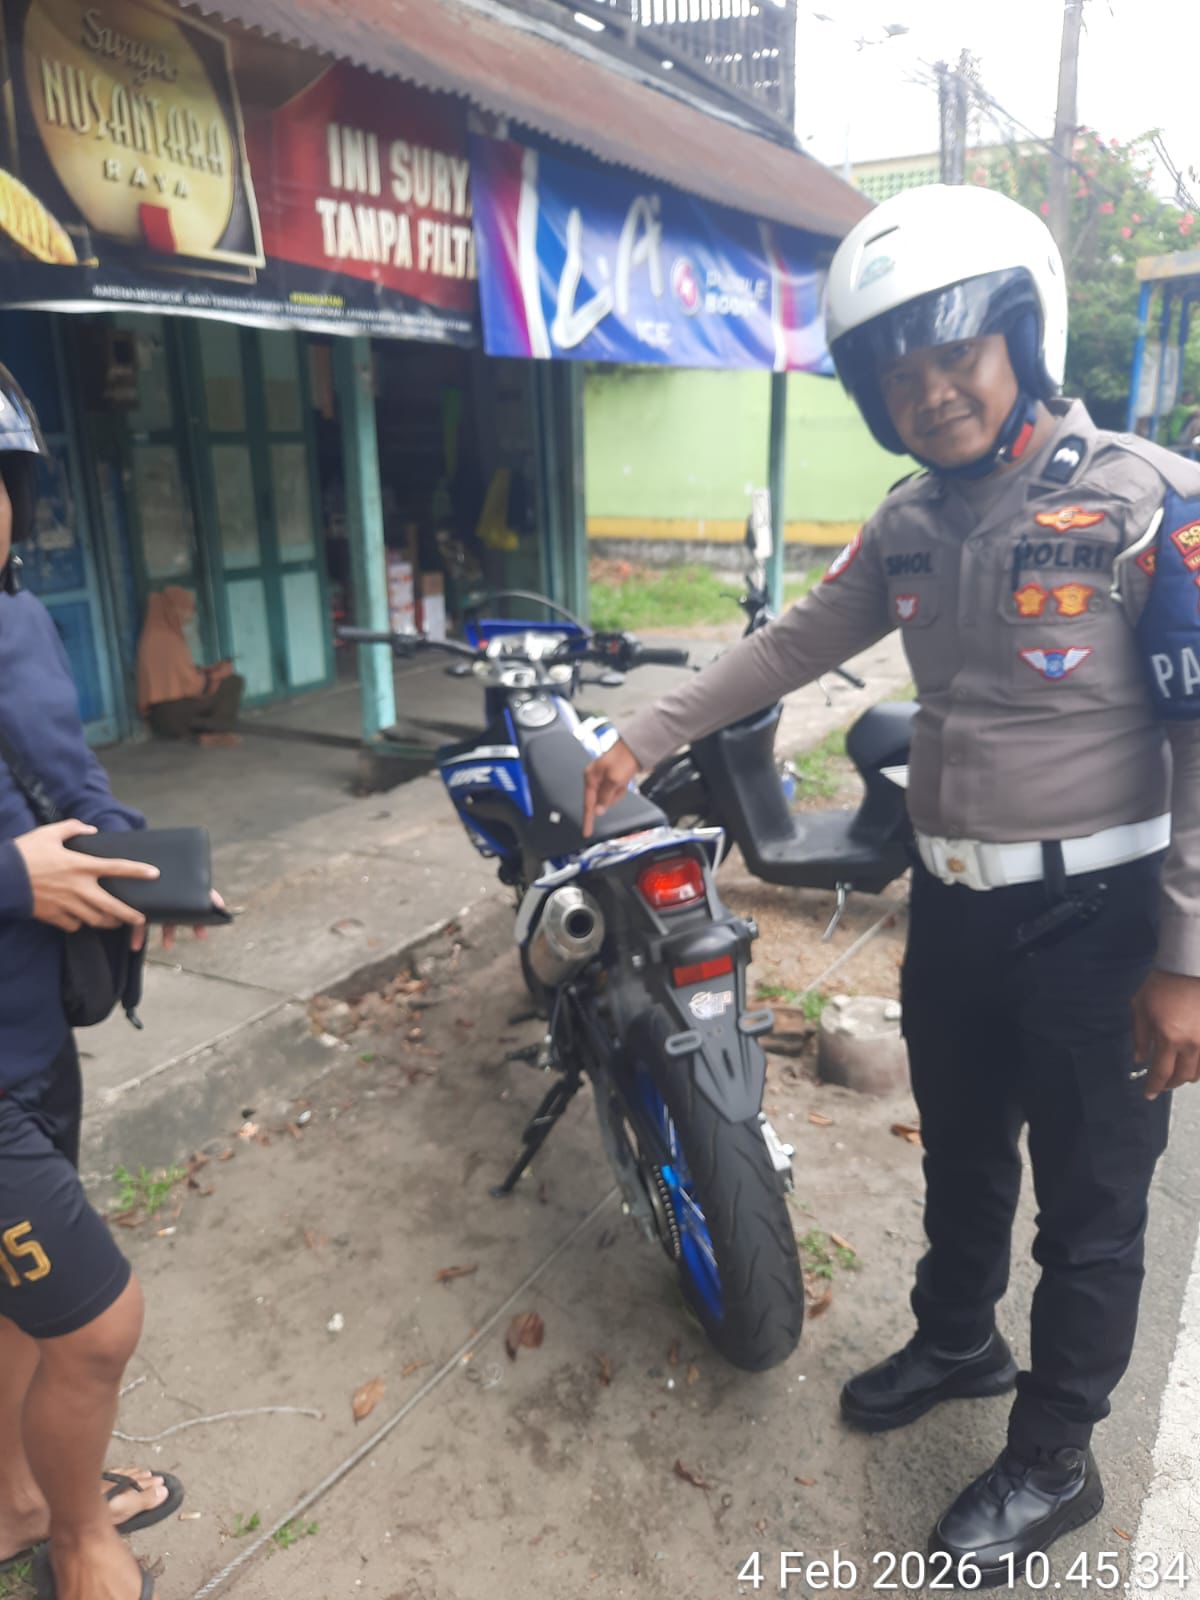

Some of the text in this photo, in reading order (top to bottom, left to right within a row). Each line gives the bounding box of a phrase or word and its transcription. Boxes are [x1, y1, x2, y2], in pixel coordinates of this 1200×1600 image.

[41, 56, 225, 176] NUSANTARA
[102, 157, 188, 200] RAYA
[328, 123, 473, 219] INI SURY
[1014, 542, 1105, 569] POLRI
